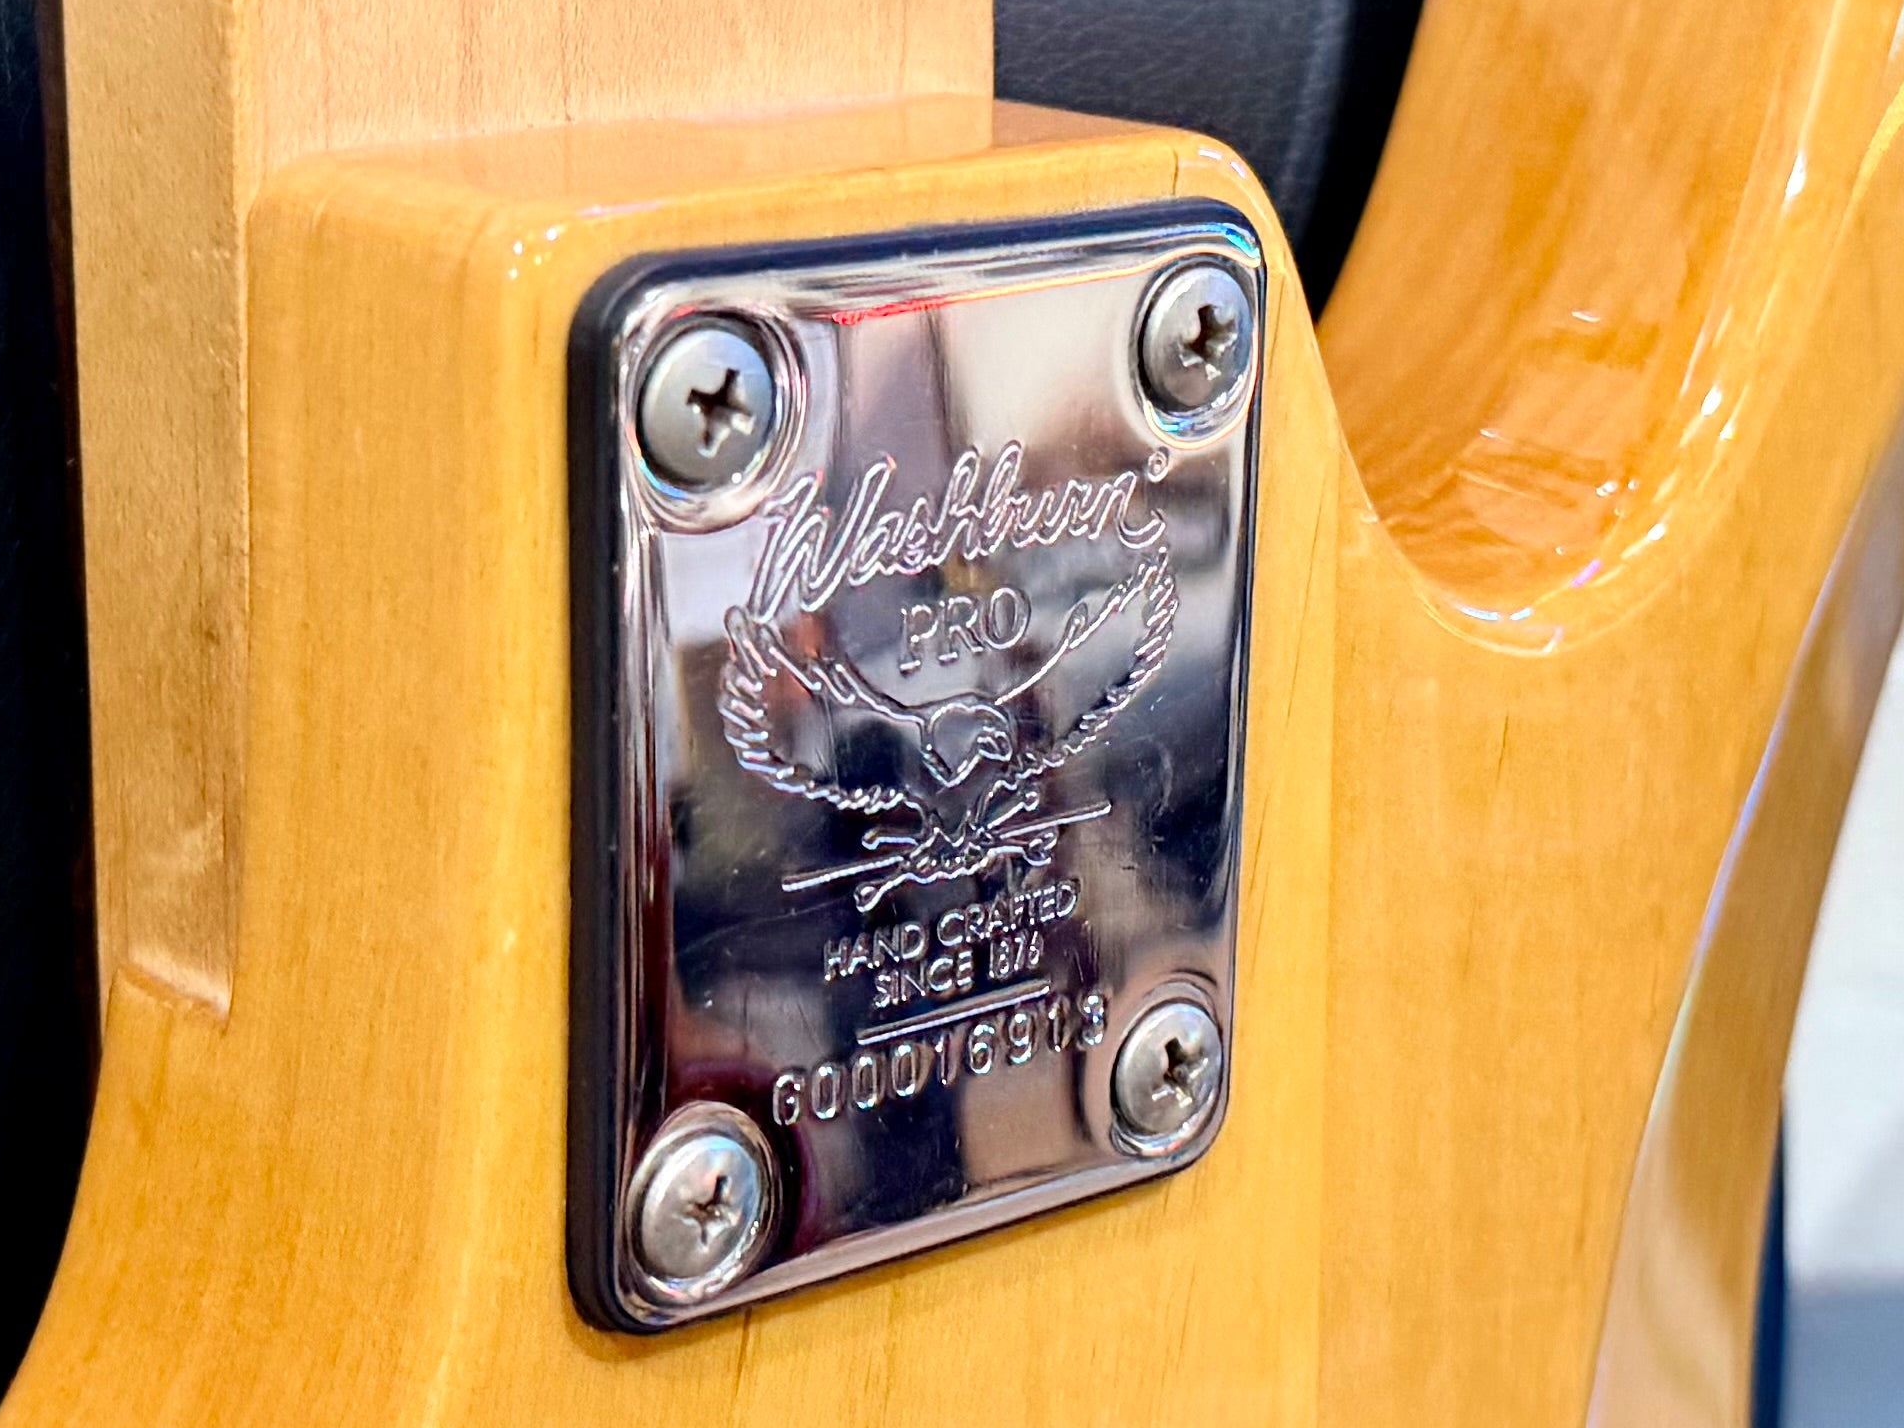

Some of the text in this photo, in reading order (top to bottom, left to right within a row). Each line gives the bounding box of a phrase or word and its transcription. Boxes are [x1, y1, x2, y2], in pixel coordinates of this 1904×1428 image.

[749, 440, 1168, 625] Washburn
[899, 585, 1032, 673] PRO
[822, 877, 1081, 983] HAND CRAFTED
[873, 927, 1045, 1009] SINCE 1876
